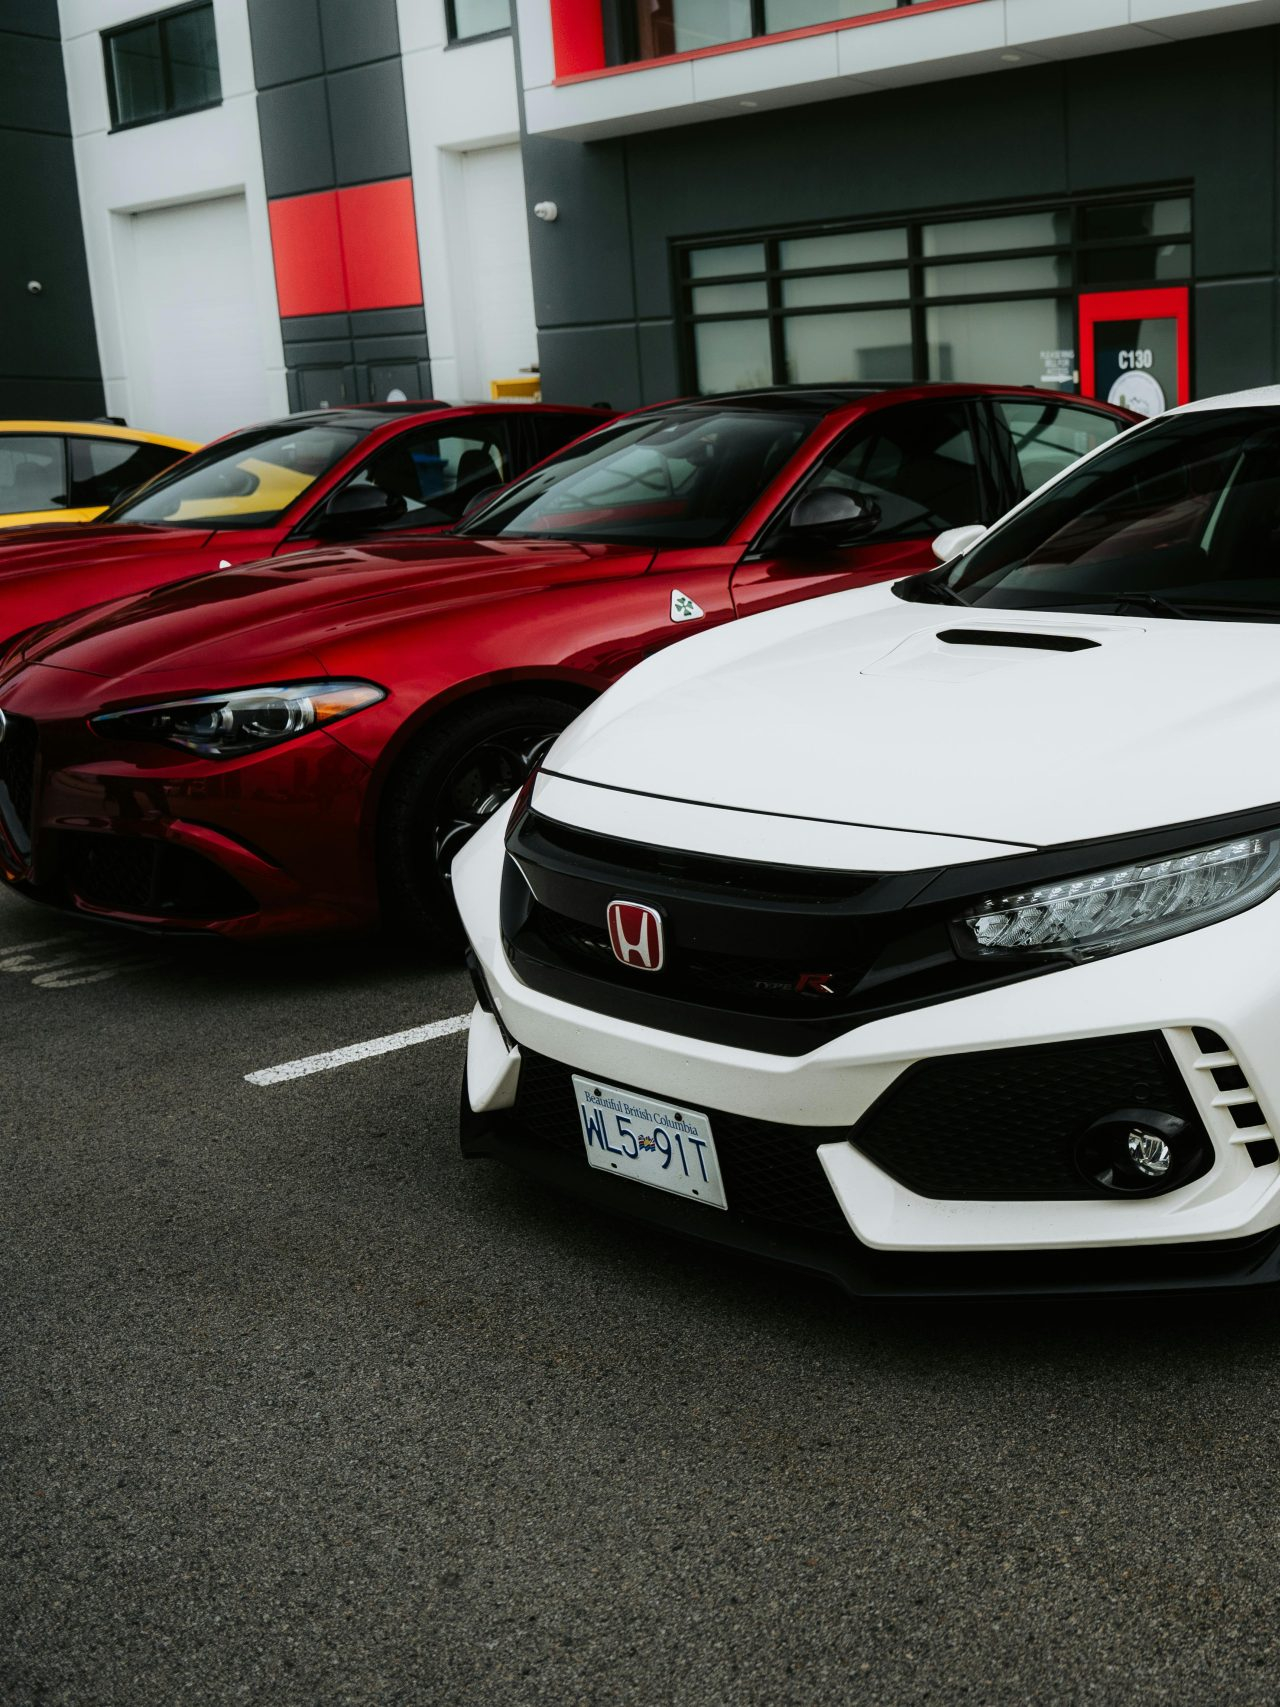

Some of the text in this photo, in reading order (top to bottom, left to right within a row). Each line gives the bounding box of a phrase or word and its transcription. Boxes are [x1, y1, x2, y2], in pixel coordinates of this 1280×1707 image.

[1118, 350, 1153, 369] C130
[752, 974, 834, 994] TYPE R
[584, 1091, 699, 1136] Beautiful British Columbia
